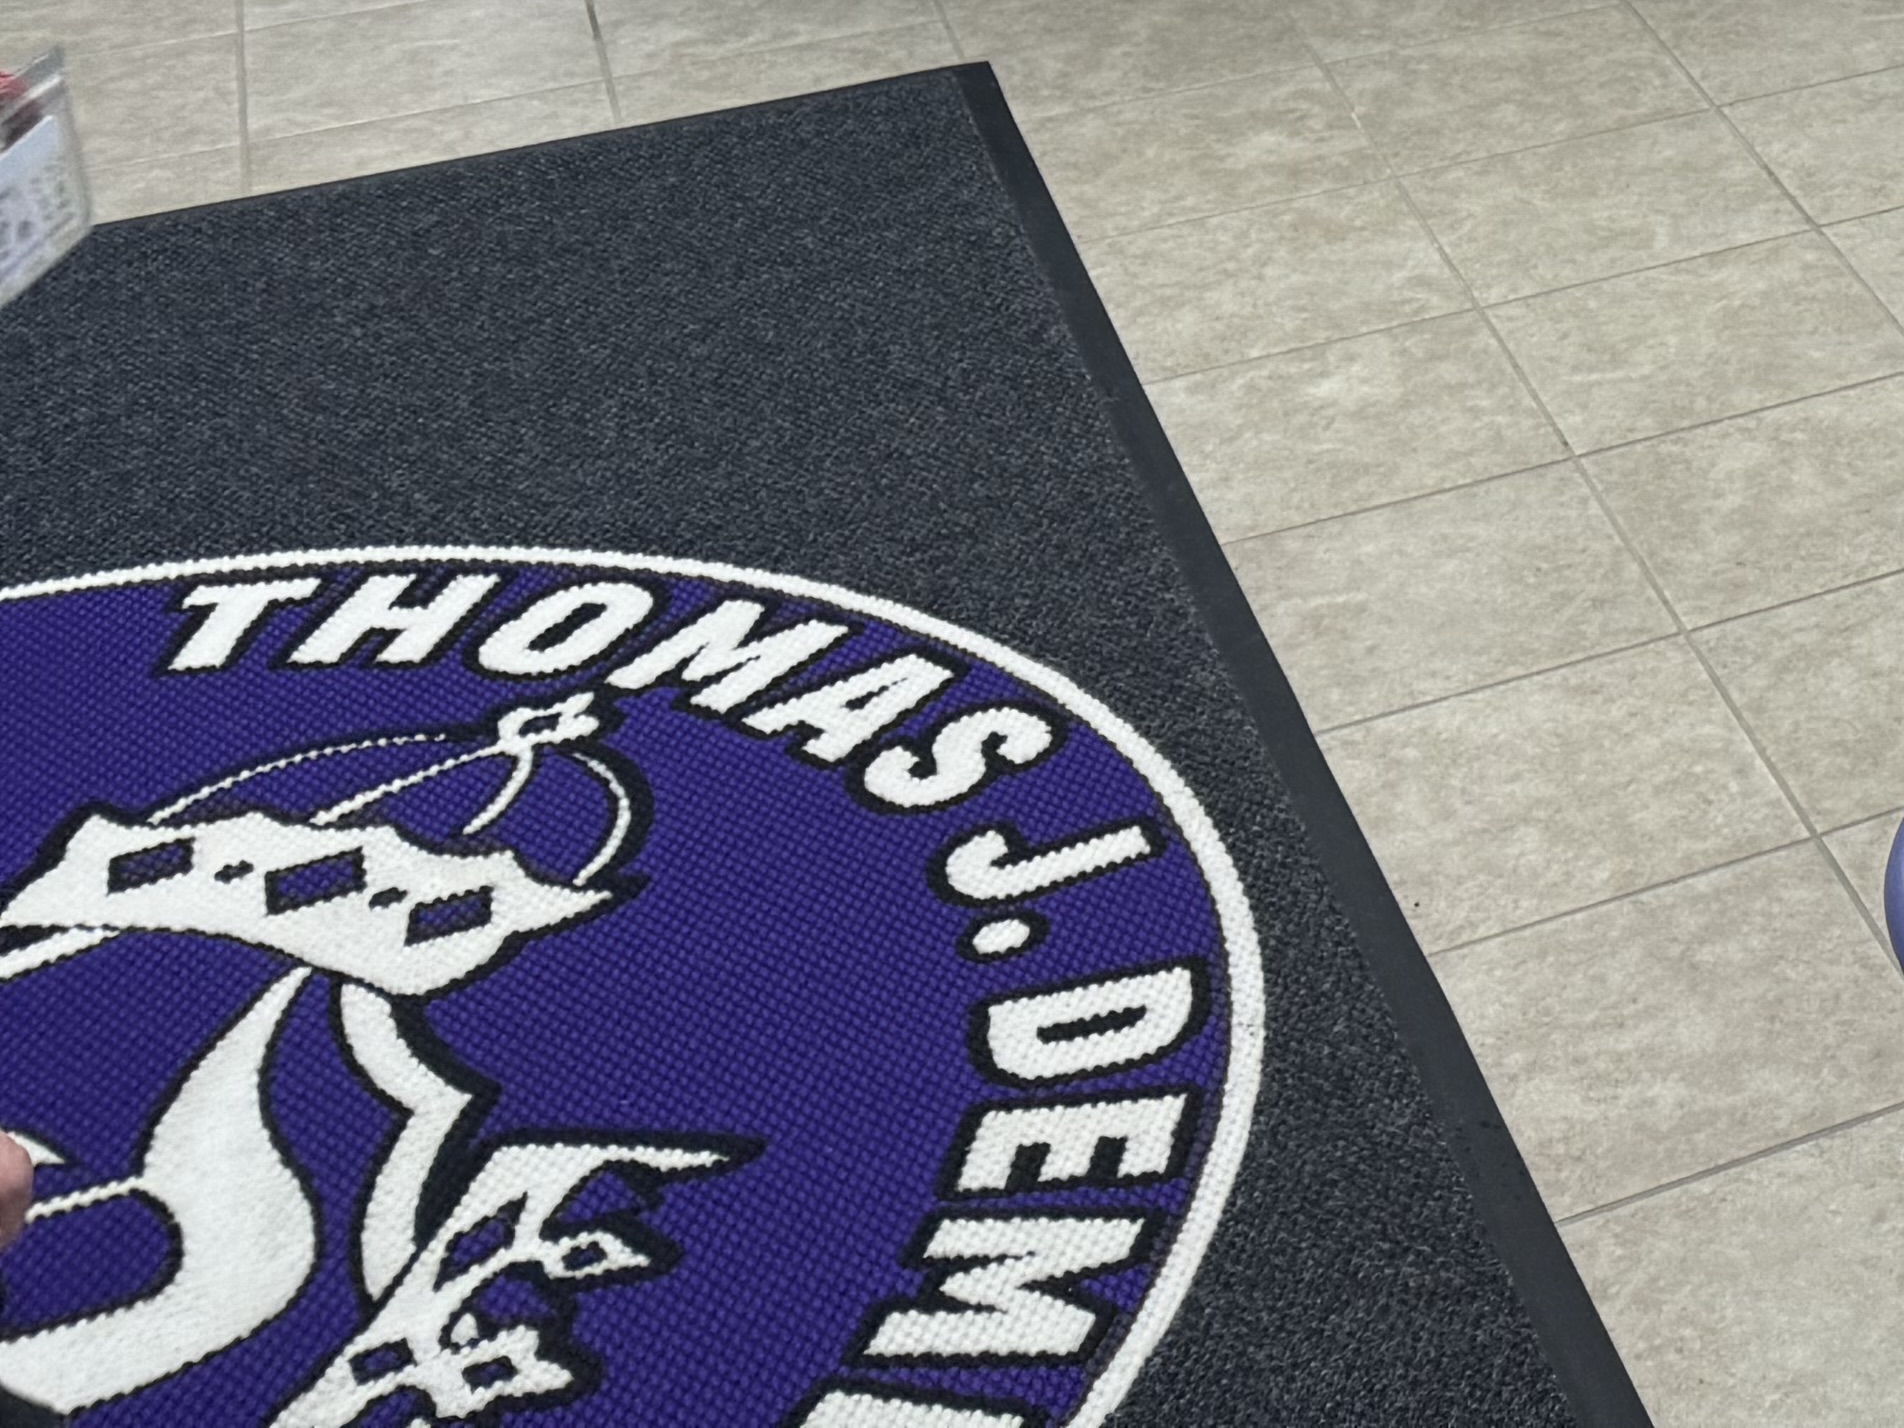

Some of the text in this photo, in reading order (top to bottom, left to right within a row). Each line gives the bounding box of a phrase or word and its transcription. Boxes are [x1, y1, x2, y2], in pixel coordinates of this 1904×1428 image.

[168, 573, 1193, 1428] THOMAS J. DEM
